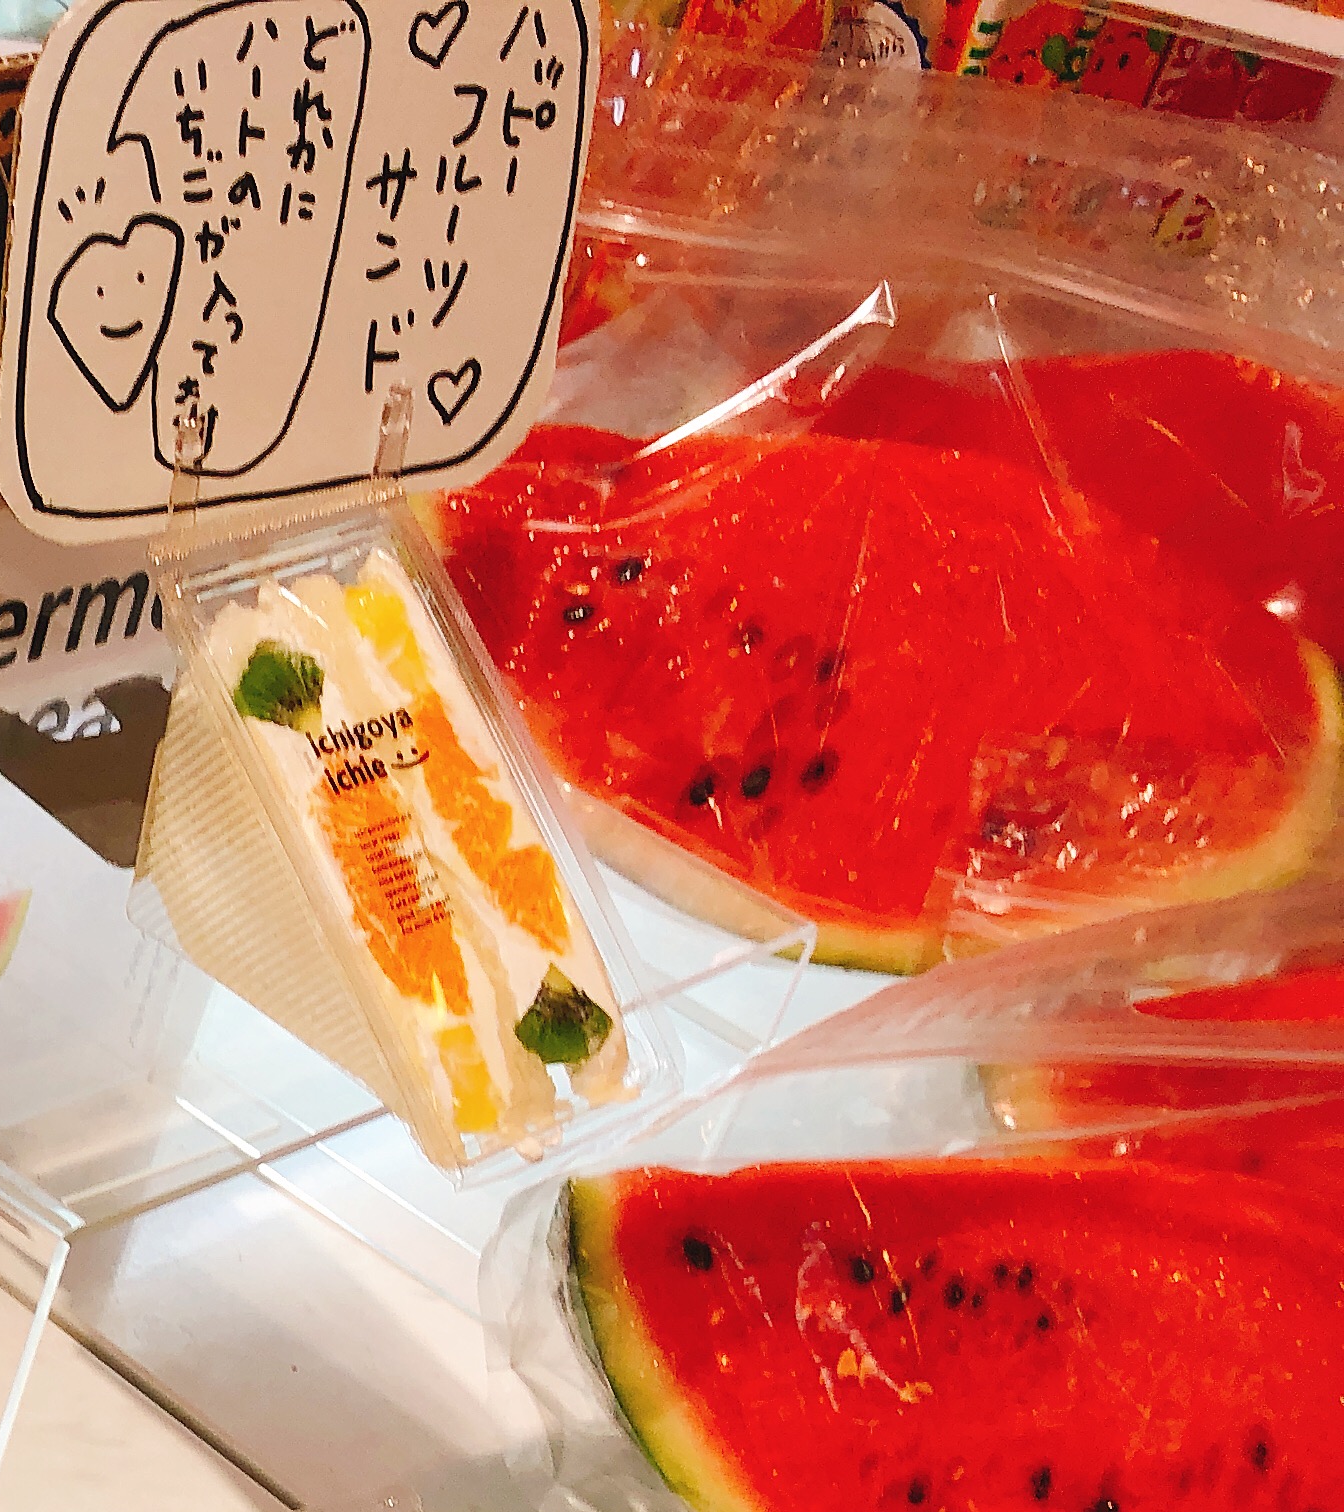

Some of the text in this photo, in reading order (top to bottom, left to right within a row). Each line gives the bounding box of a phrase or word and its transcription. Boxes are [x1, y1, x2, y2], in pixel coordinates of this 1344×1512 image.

[228, 18, 279, 210] ハートの
[423, 83, 488, 328] フルーツ
[365, 147, 418, 394] サンド
